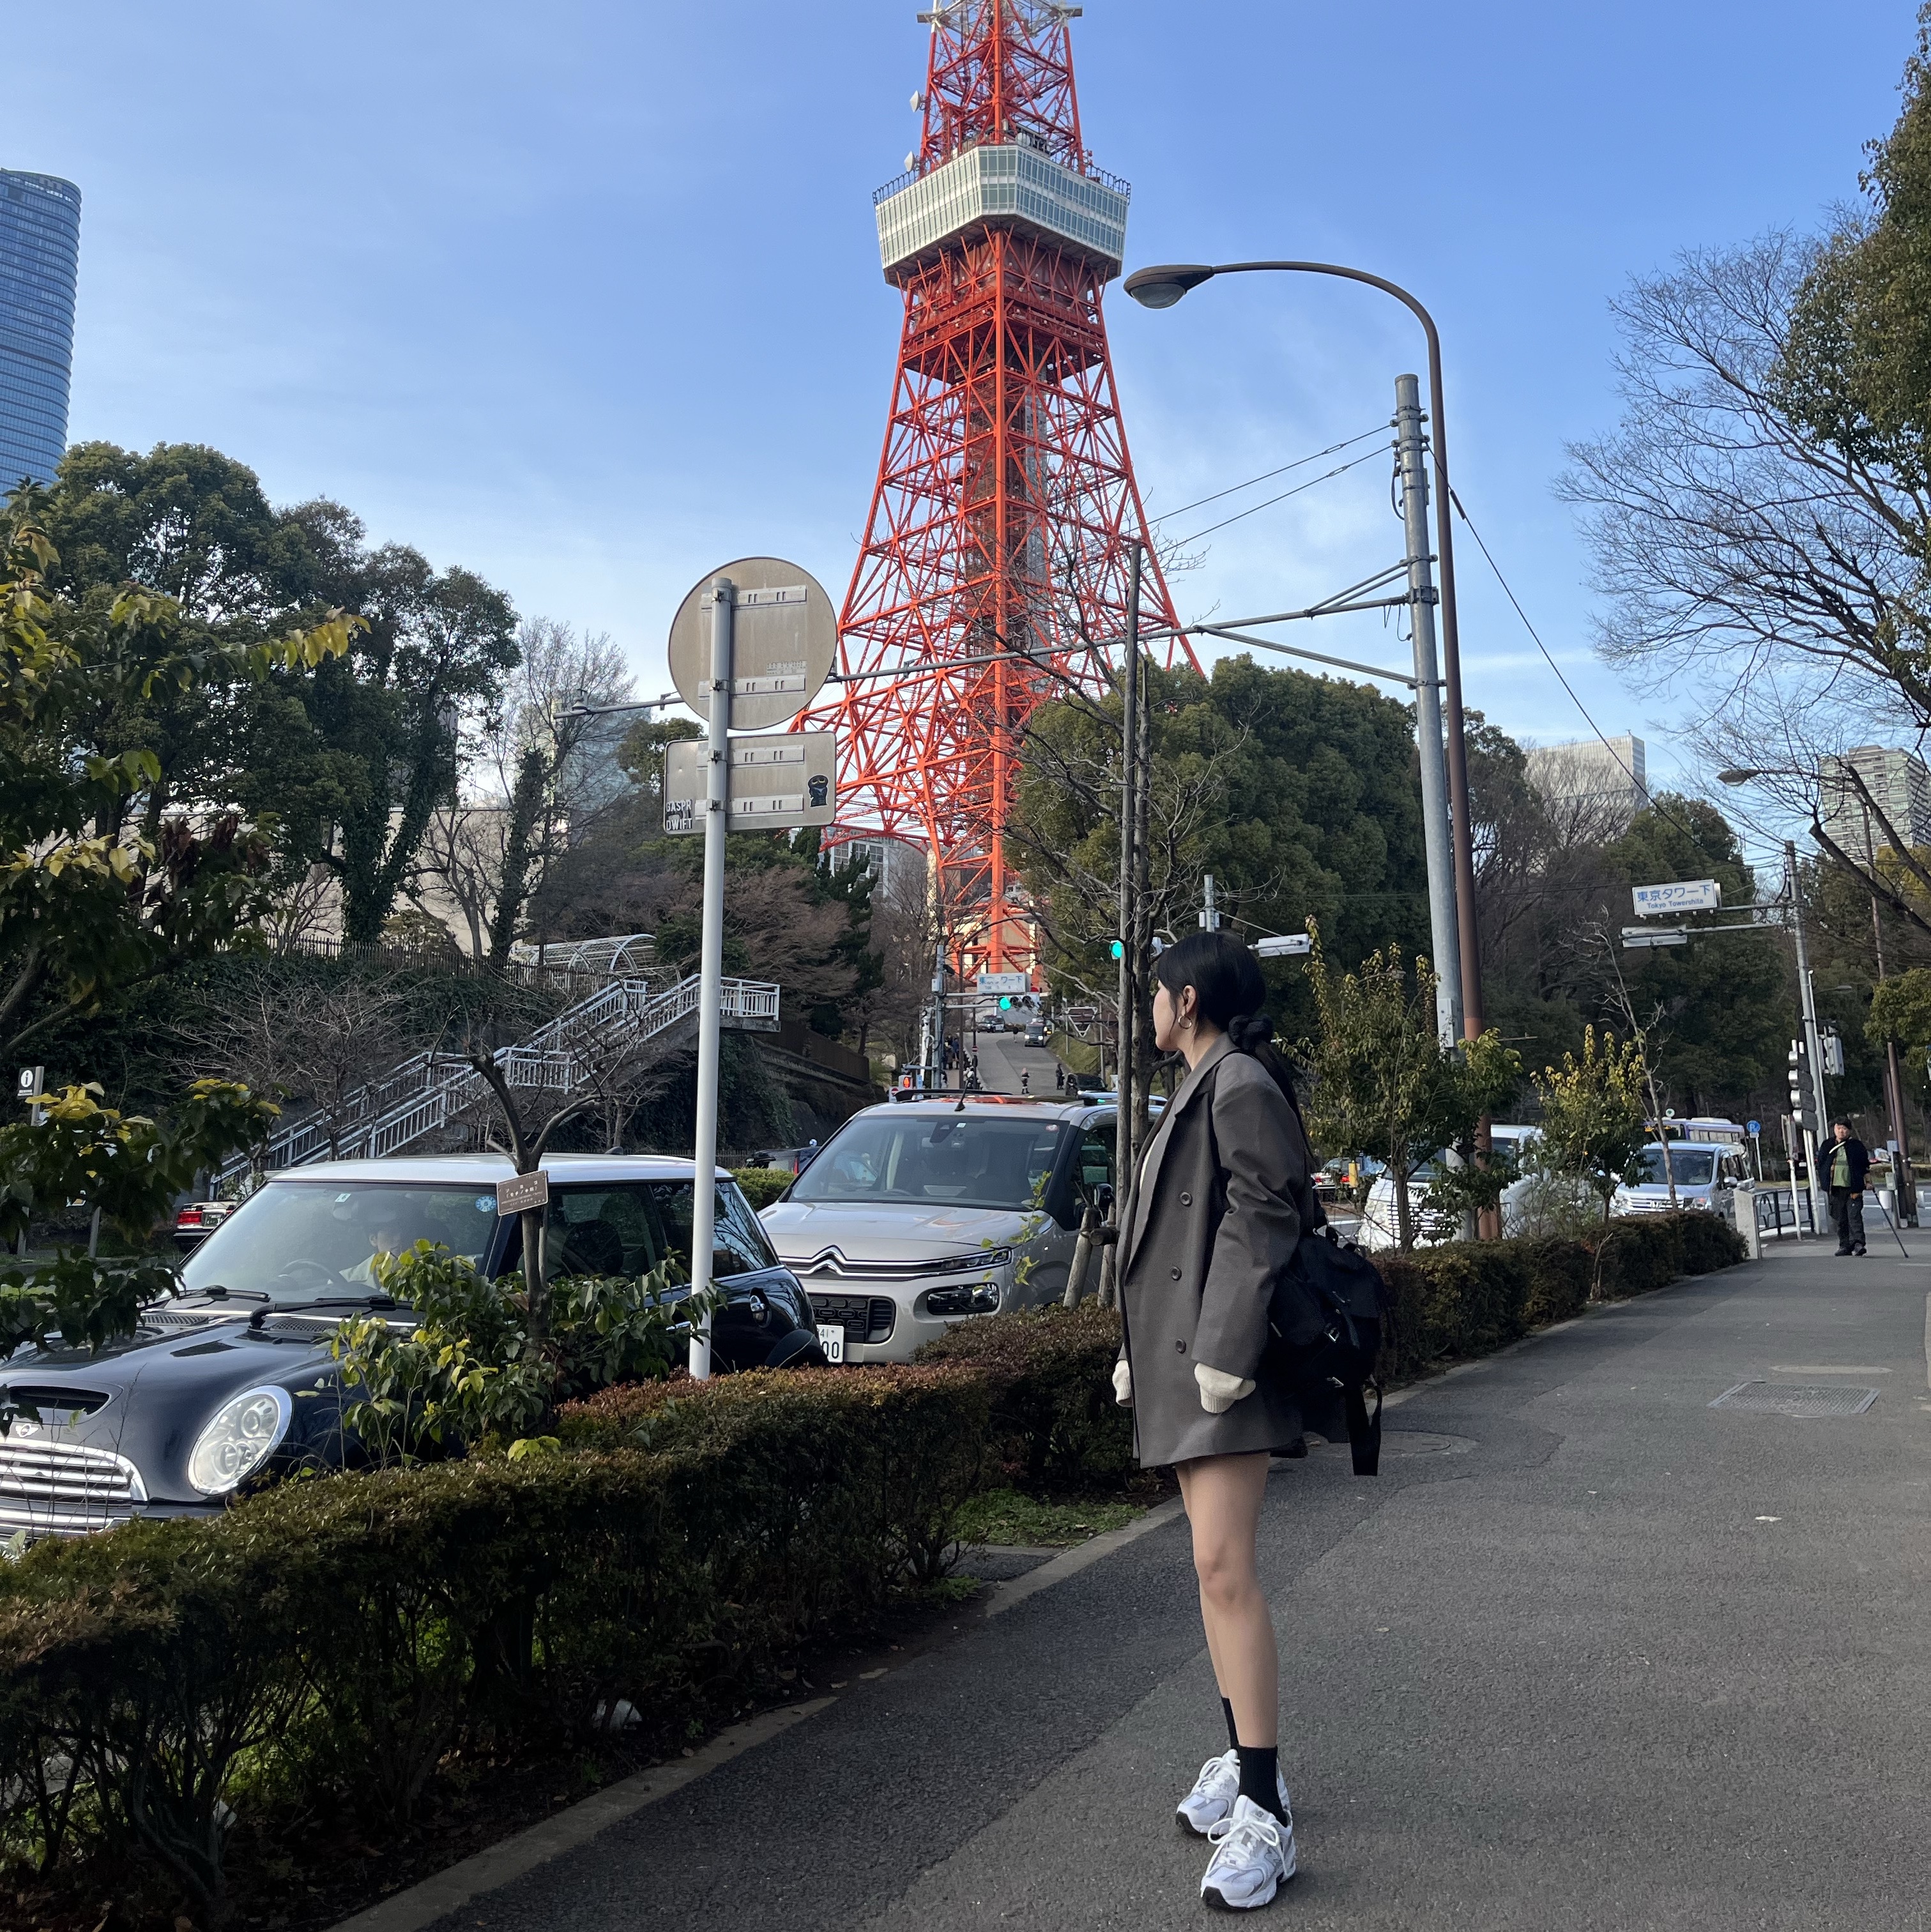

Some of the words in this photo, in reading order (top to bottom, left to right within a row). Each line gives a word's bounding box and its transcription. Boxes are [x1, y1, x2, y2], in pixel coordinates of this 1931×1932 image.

[666, 799, 692, 812] GASPR
[1637, 884, 1711, 902] 東京タワー下
[1668, 898, 1704, 908] Towershita
